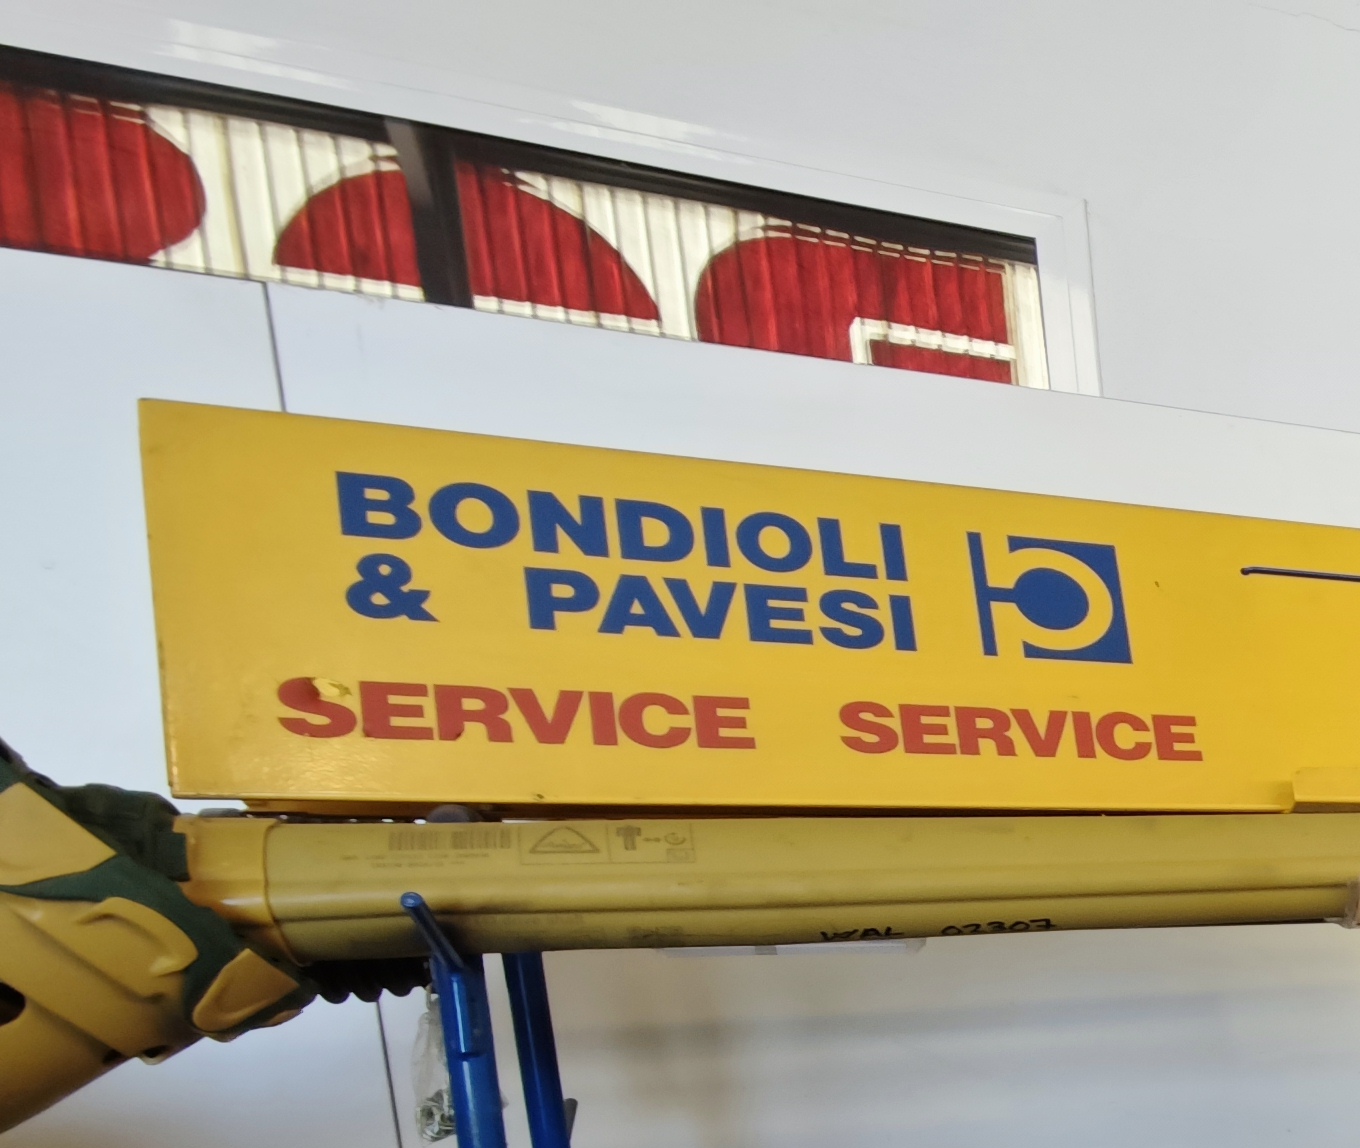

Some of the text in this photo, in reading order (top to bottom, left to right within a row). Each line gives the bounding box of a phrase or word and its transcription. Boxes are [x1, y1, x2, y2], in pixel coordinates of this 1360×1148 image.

[335, 471, 909, 582] BONDIOLI
[345, 552, 918, 652] & PAVESI
[277, 676, 1204, 761] SERVICE SERVICE
